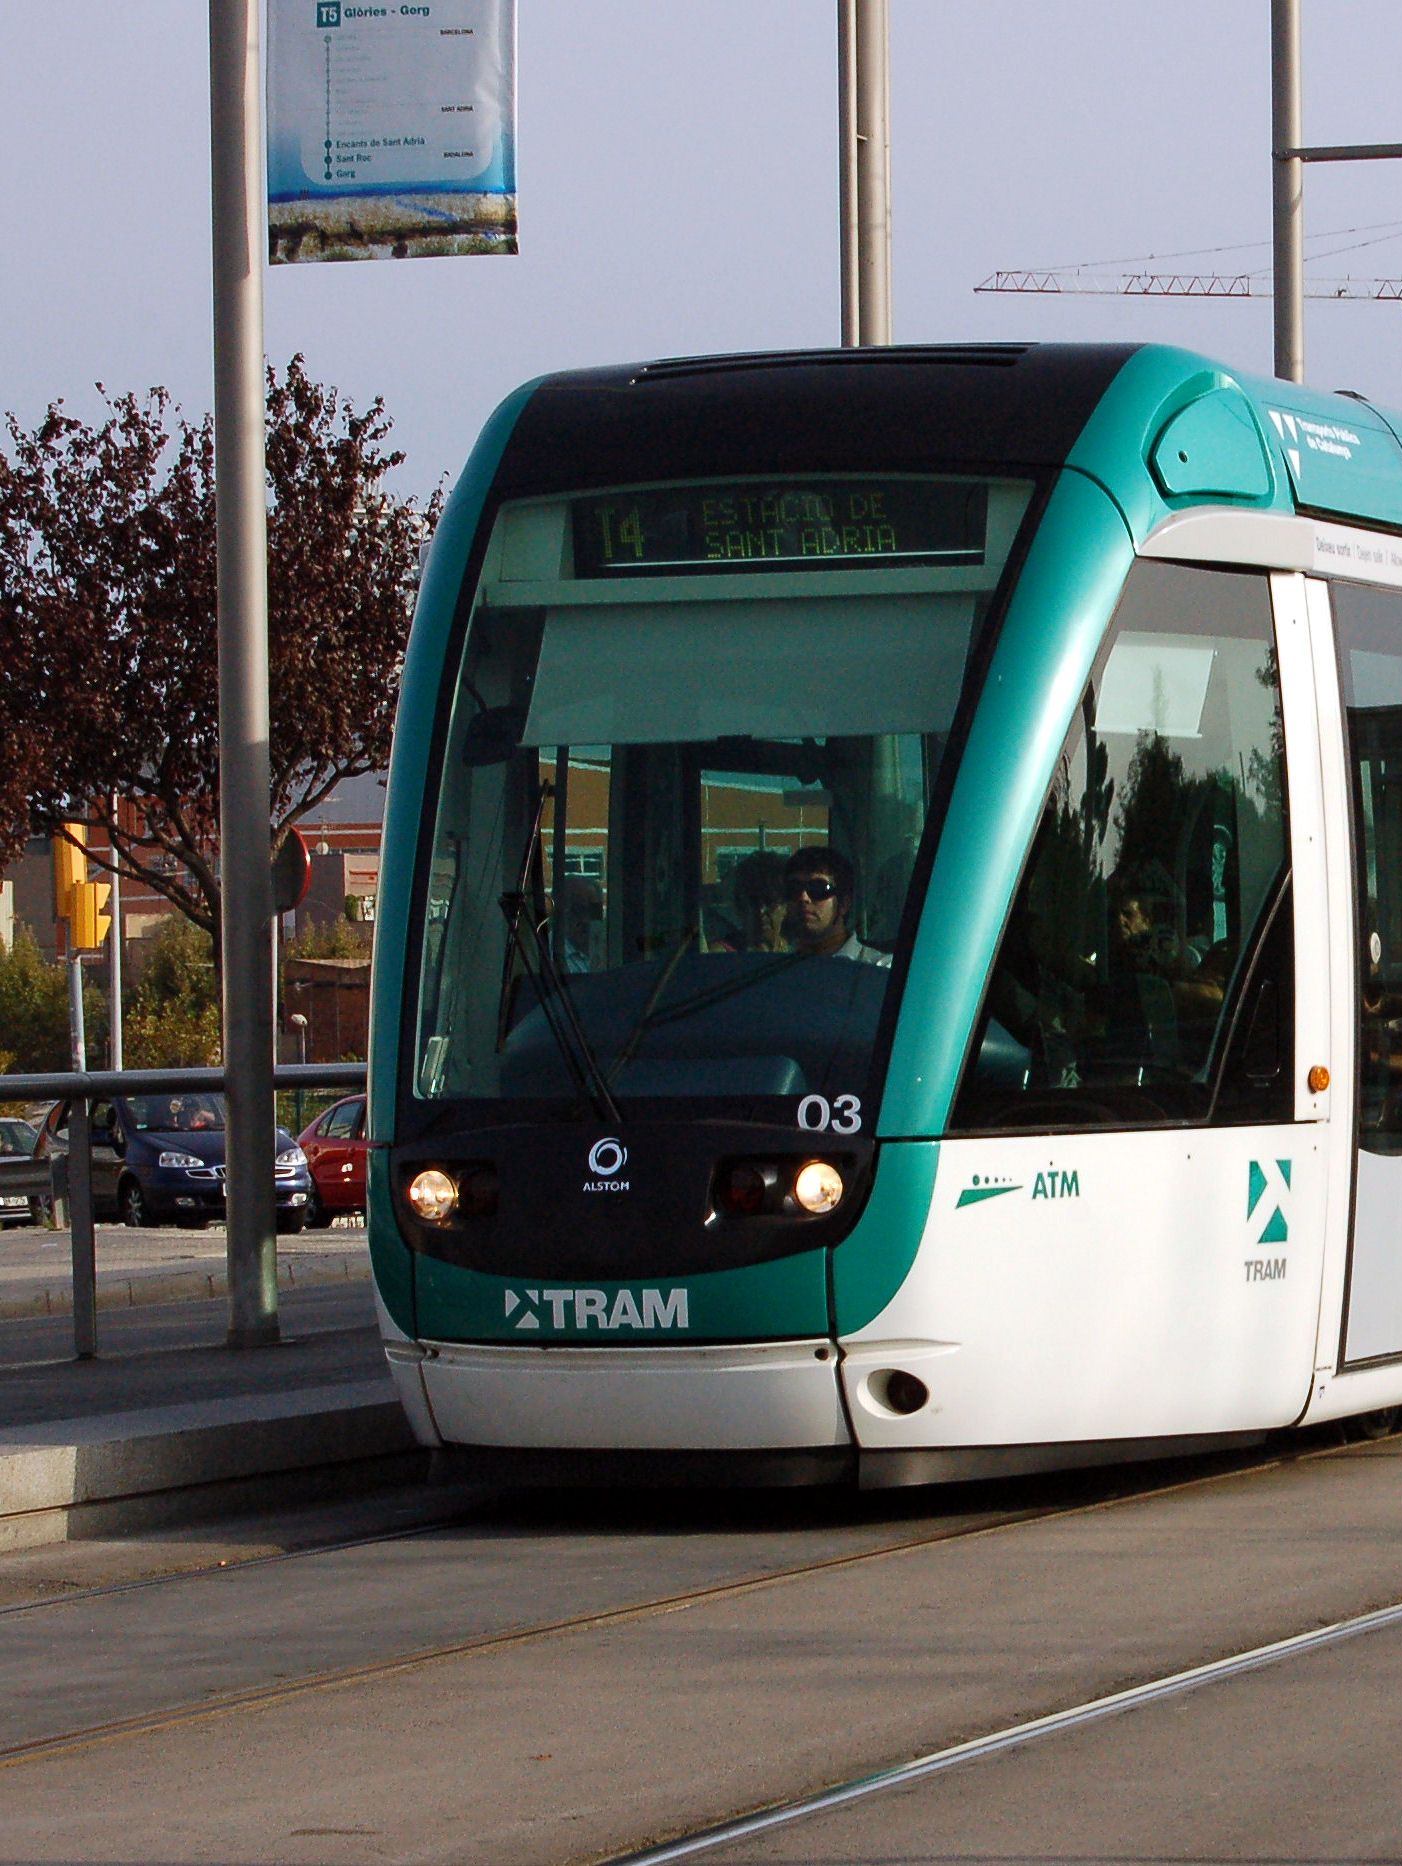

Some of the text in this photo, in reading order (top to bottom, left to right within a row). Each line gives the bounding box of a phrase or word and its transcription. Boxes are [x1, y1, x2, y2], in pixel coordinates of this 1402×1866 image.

[321, 6, 338, 23] T5
[344, 6, 387, 18] Glòries
[400, 5, 430, 17] Gorg
[370, 138, 380, 147] de
[382, 137, 401, 146] Sant
[336, 154, 354, 162] Sant
[336, 169, 356, 179] Gorg
[850, 494, 887, 519] DE
[705, 525, 896, 558] SANT ADRIA
[797, 1094, 862, 1134] 03
[583, 1181, 630, 1192] ALSTOM
[1031, 1169, 1081, 1200] ATM
[1243, 1258, 1287, 1282] TRAM
[541, 1288, 689, 1329] TRAM
